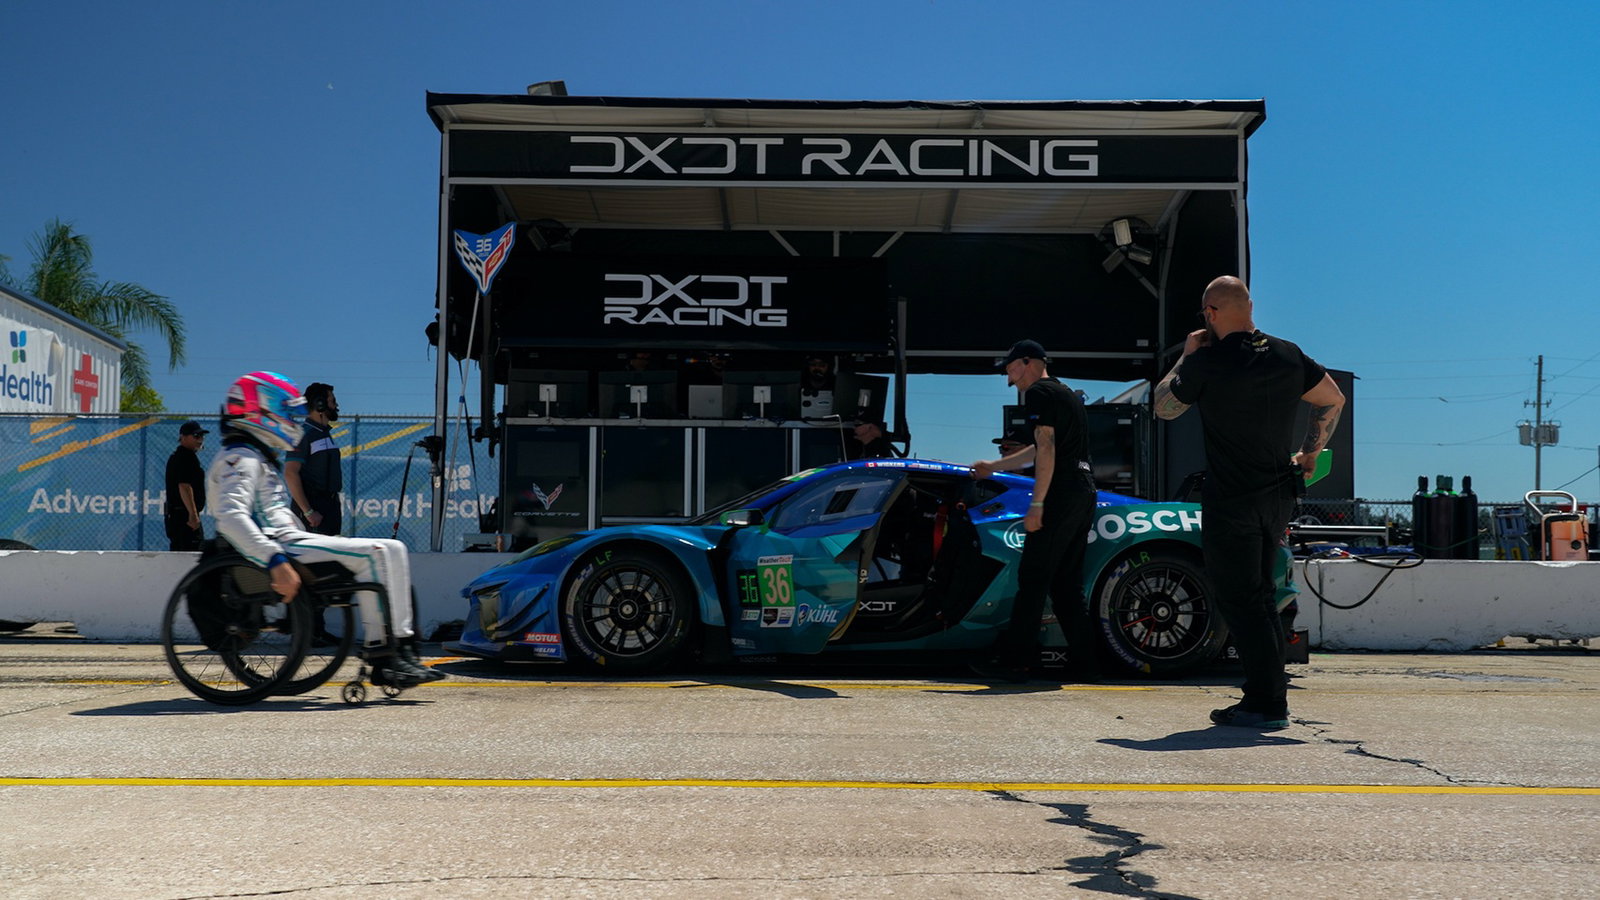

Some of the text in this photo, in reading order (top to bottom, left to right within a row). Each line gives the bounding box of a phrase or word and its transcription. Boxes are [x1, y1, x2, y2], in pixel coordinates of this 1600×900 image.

[570, 136, 1098, 176] DXDT RACING
[476, 238, 492, 253] 36
[604, 273, 787, 306] DXDT
[604, 306, 787, 326] RACING
[595, 549, 613, 566] LF
[739, 575, 759, 604] 36
[762, 567, 791, 604] 36
[806, 604, 839, 623] KÜHL
[858, 600, 896, 612] XDT
[527, 633, 558, 642] MOTUL
